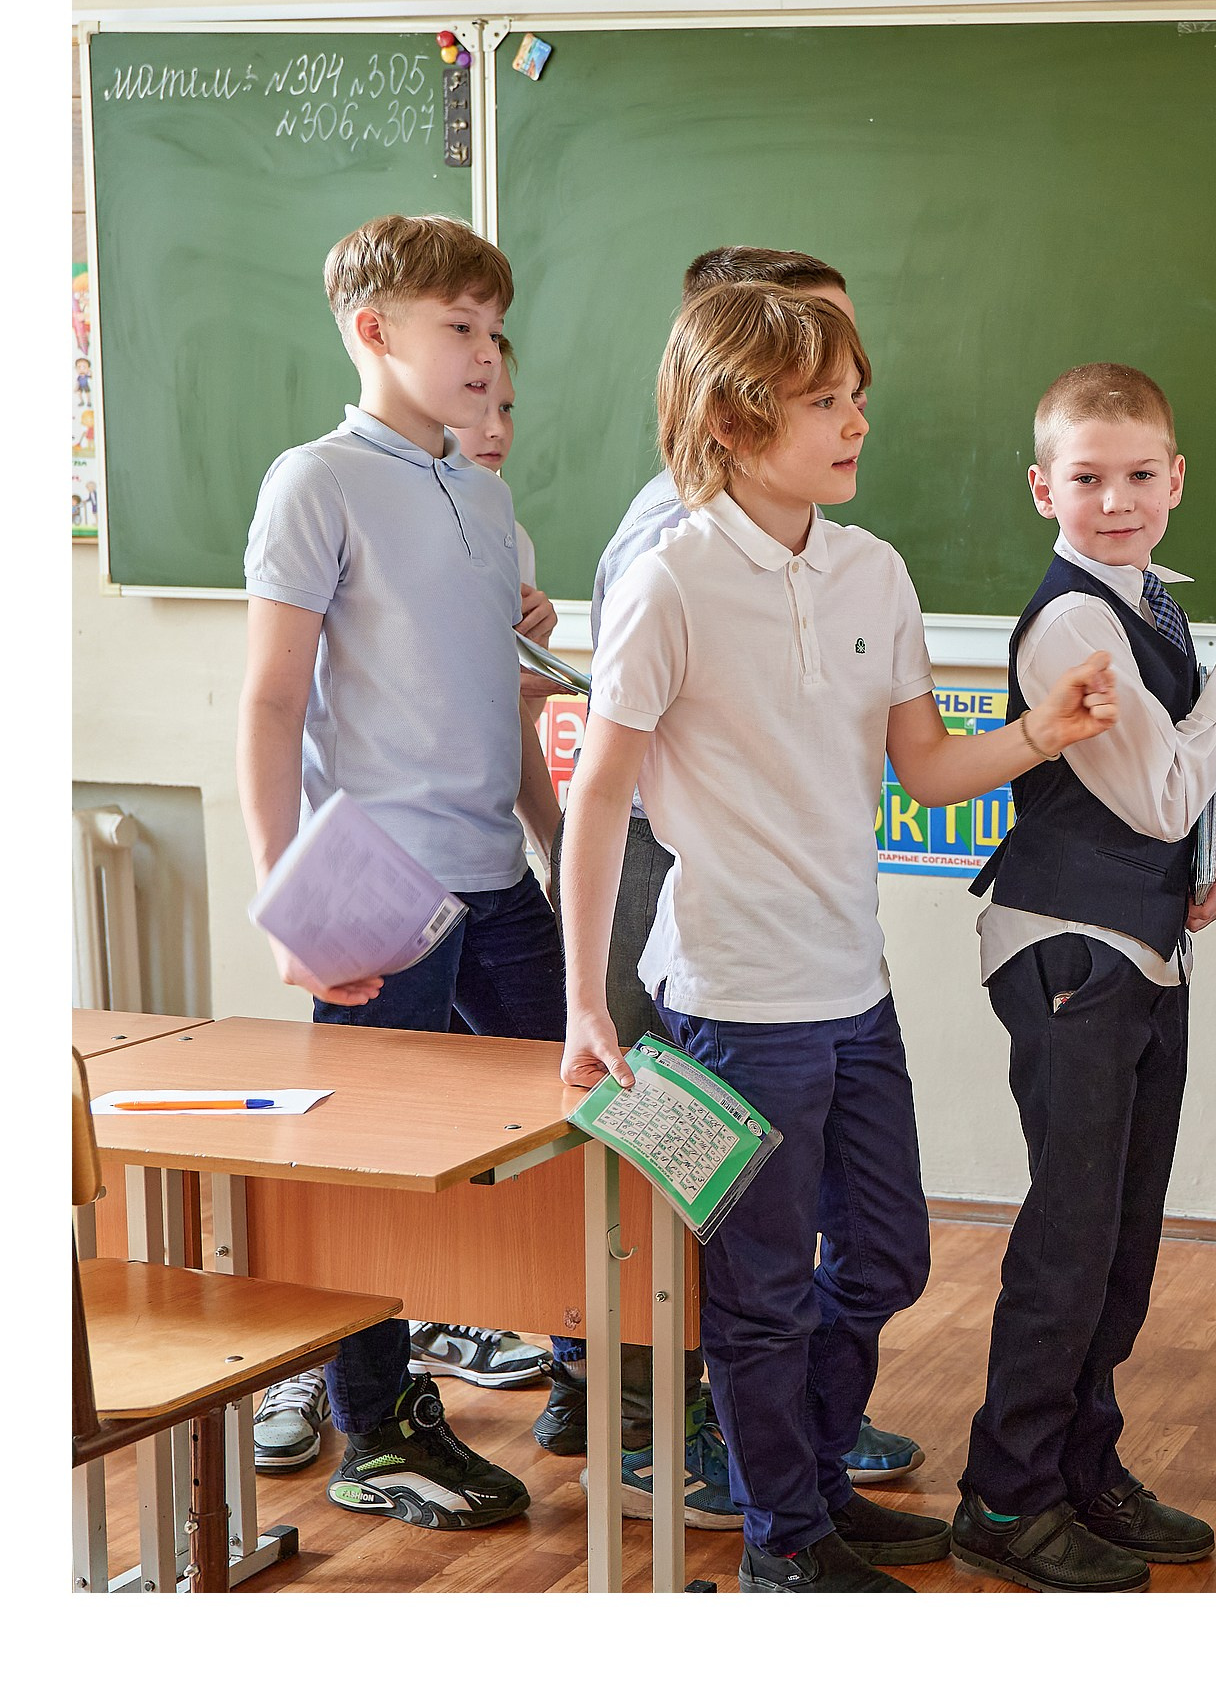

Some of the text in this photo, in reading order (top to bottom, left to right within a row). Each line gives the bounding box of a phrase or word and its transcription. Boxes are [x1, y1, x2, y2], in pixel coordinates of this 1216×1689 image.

[936, 694, 993, 714] НЫЕ
[922, 856, 982, 867] СОГЛАСНЫЕ
[342, 1490, 375, 1502] FASHION
